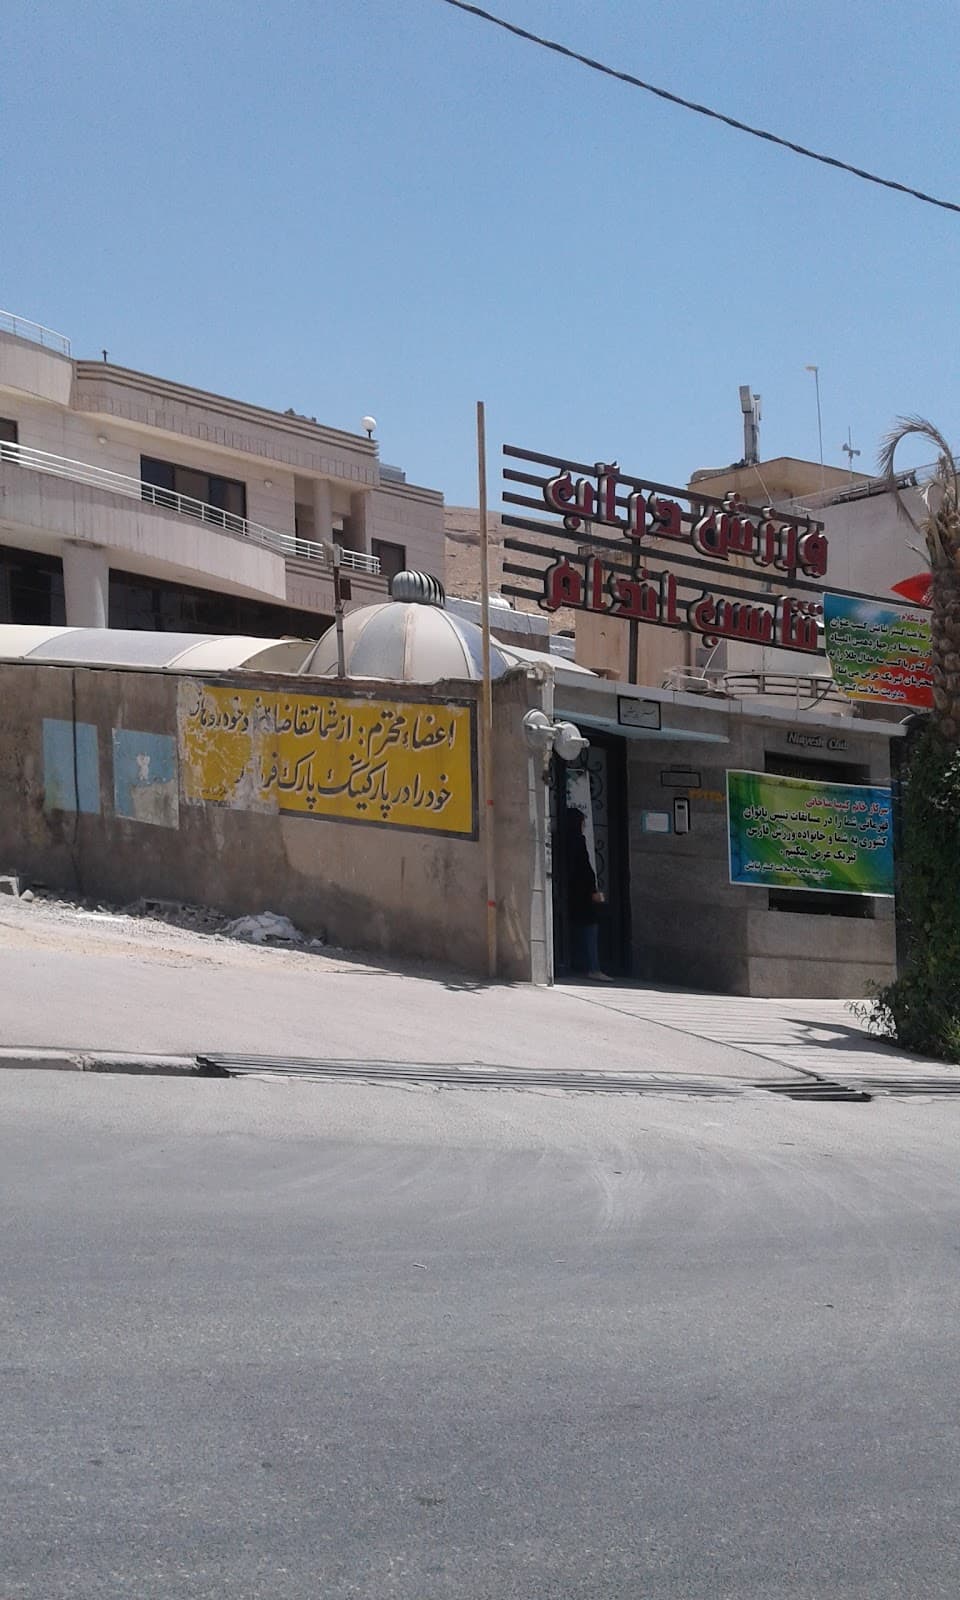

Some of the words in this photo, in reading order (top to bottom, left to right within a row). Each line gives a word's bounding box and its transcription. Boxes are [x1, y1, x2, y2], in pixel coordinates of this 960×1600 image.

[692, 491, 829, 578] ورزش
[538, 552, 682, 624] اندام
[687, 590, 823, 648] تناسب
